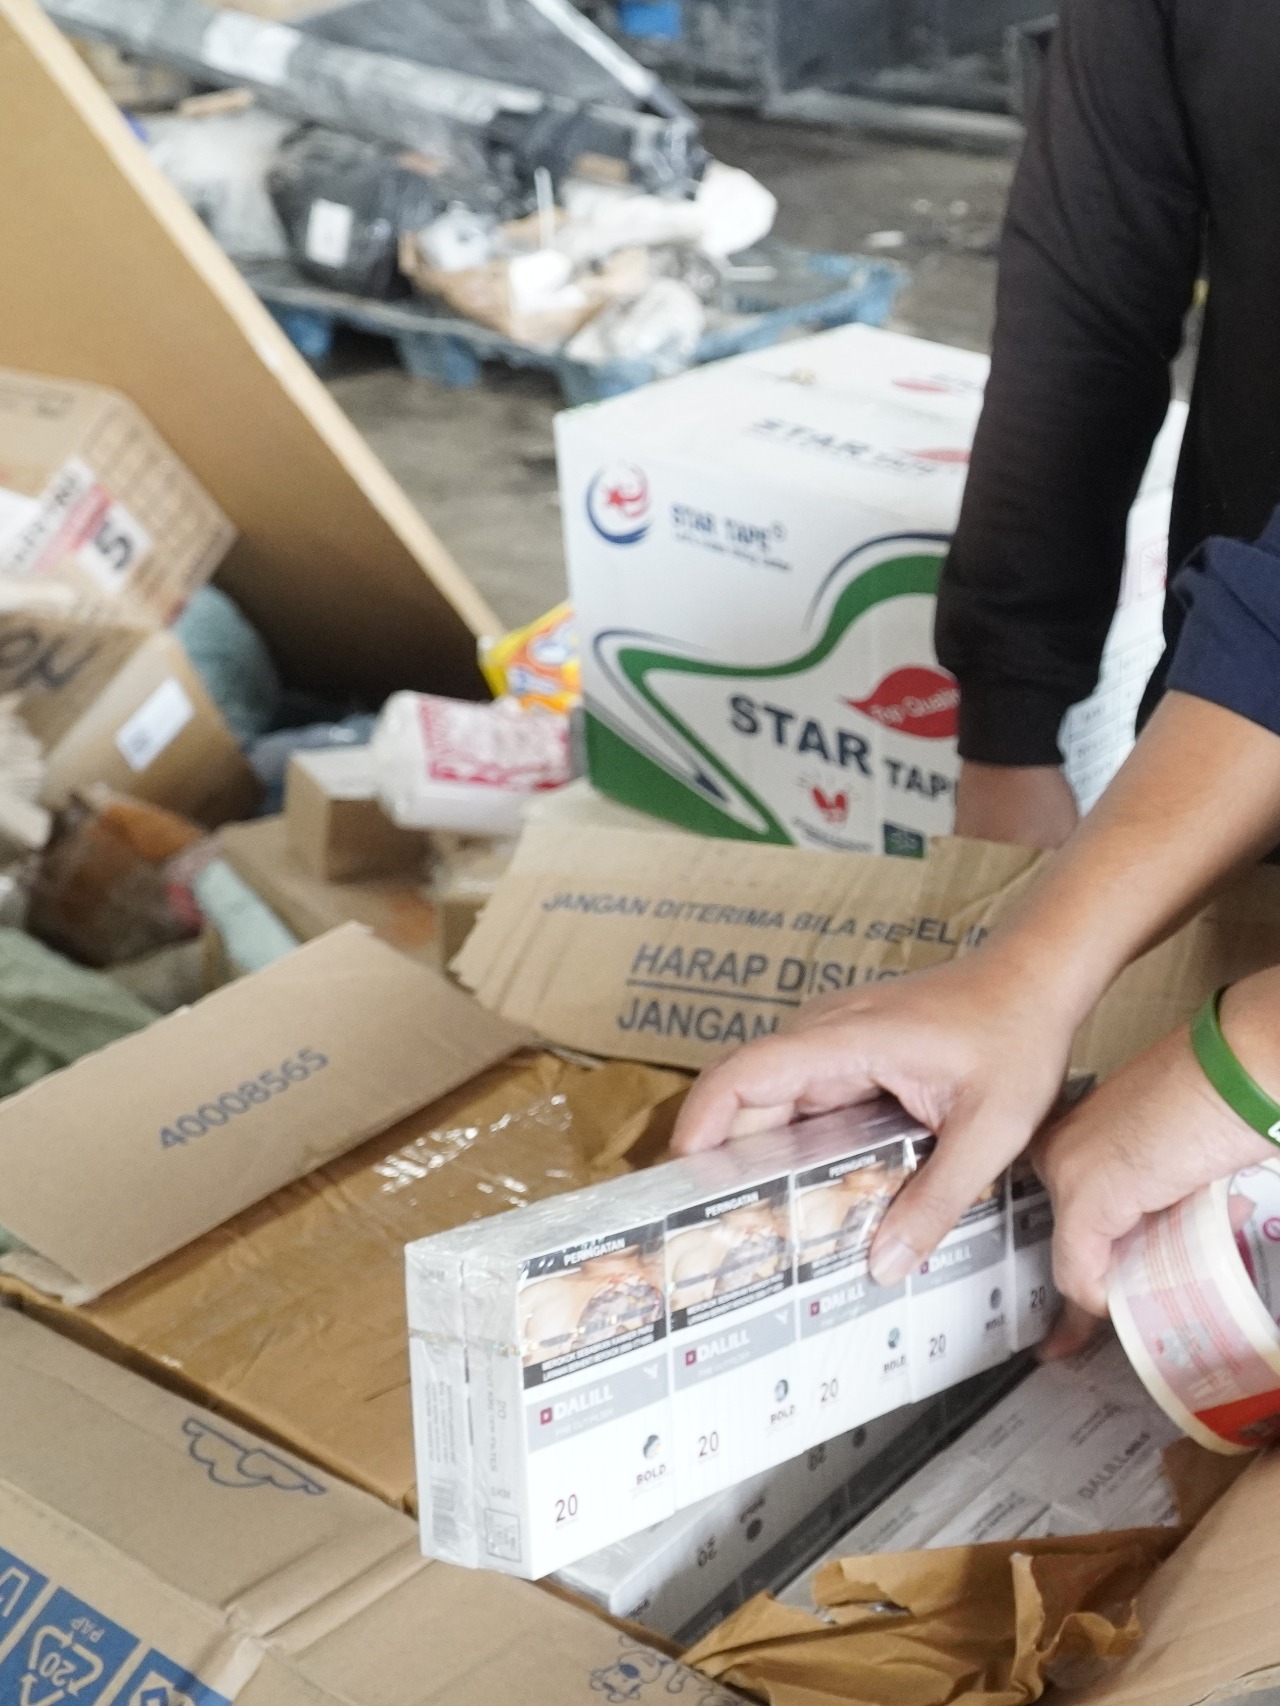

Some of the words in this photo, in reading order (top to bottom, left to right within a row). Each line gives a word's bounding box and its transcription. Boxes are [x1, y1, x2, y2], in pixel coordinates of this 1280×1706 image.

[730, 693, 872, 776] STAR
[884, 757, 958, 800] TAP
[540, 893, 647, 916] JANGAN
[653, 899, 785, 928] DITERIMA
[792, 911, 856, 935] BILA
[631, 943, 769, 987] HARAP
[615, 997, 780, 1045] JANGAN
[160, 1046, 329, 1149] 40008565
[705, 1191, 759, 1218] PERINGATAN
[563, 1238, 625, 1266] PERINGATAN
[697, 1330, 750, 1362] DALILL
[929, 1334, 947, 1358] 20
[556, 1384, 613, 1419] DALILL
[820, 1378, 839, 1403] 20
[769, 1405, 796, 1425] BOLD
[698, 1431, 719, 1457] 20
[636, 1464, 666, 1485] BOLD
[555, 1493, 578, 1522] 20
[39, 1651, 77, 1687] 20
